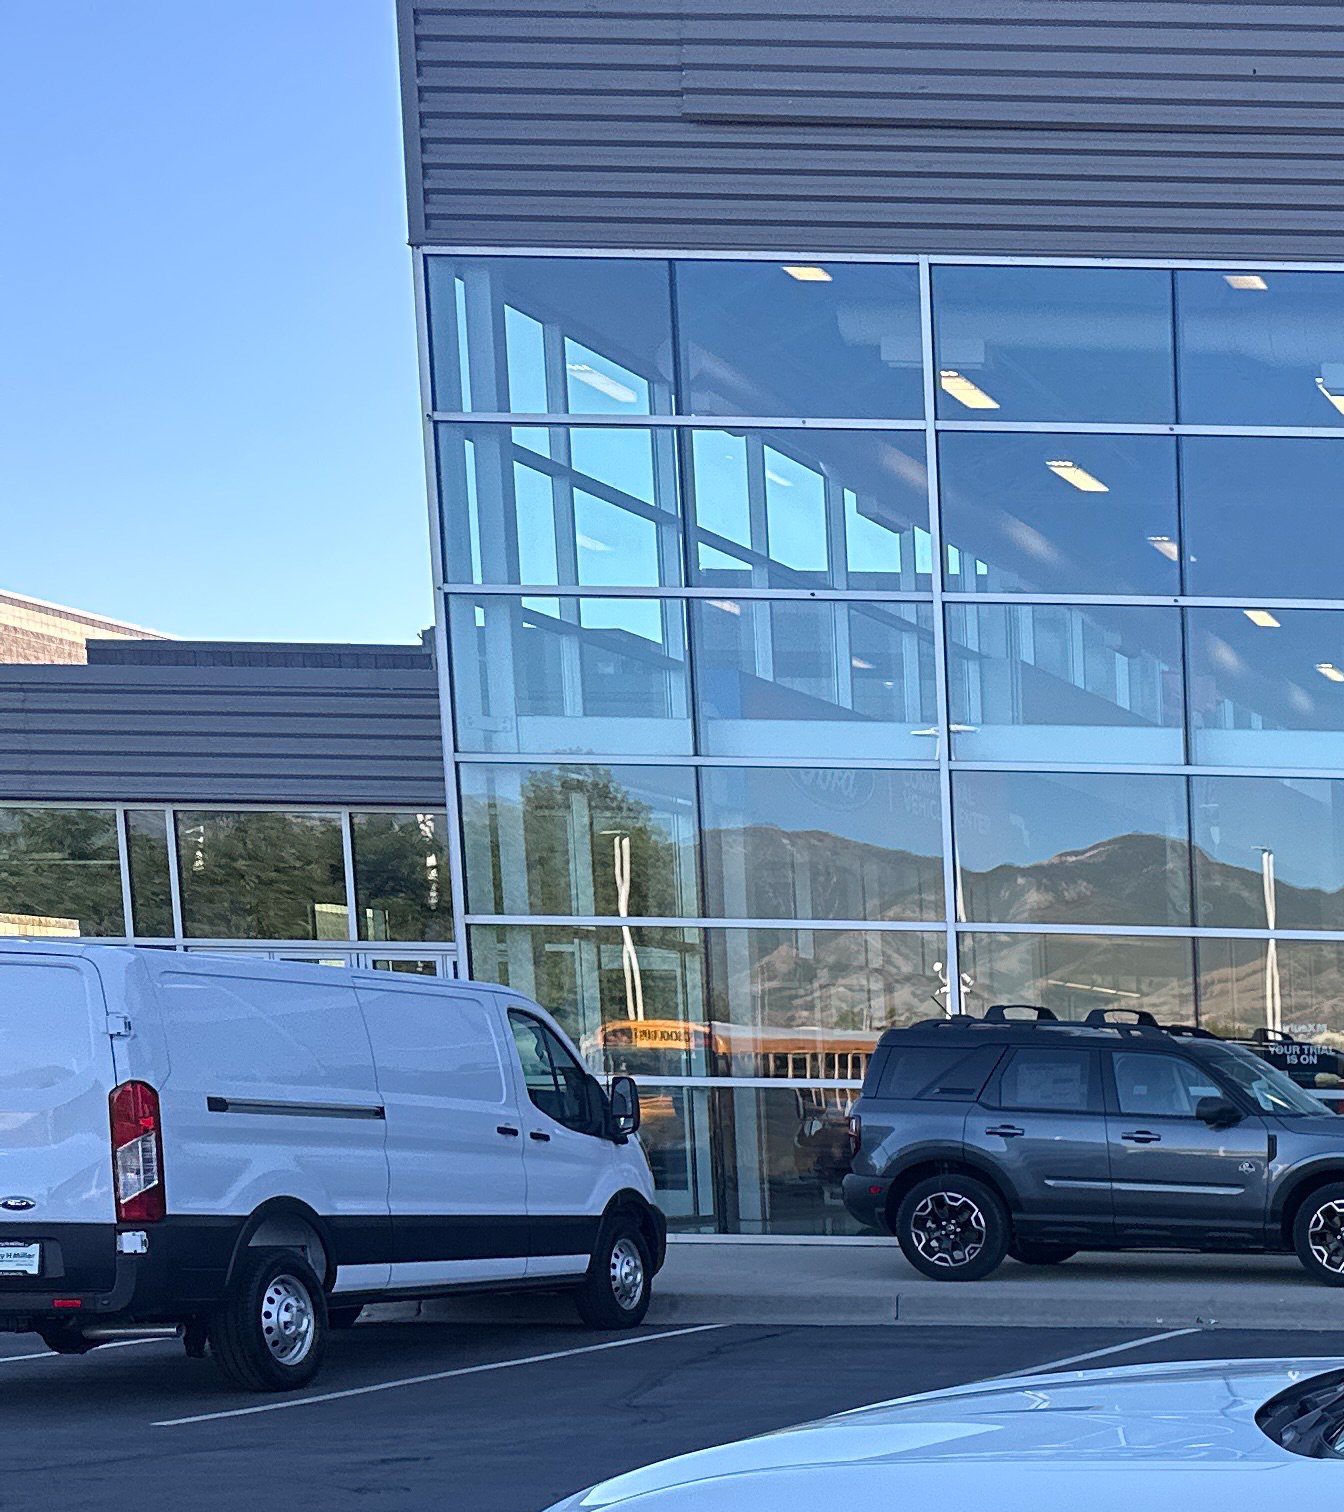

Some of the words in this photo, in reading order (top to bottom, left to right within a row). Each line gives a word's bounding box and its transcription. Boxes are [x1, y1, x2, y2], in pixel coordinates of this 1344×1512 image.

[1268, 1045, 1300, 1055] YOUR
[1302, 1045, 1336, 1055] TRIAL
[1287, 1055, 1298, 1065] IS
[1300, 1055, 1318, 1065] ON
